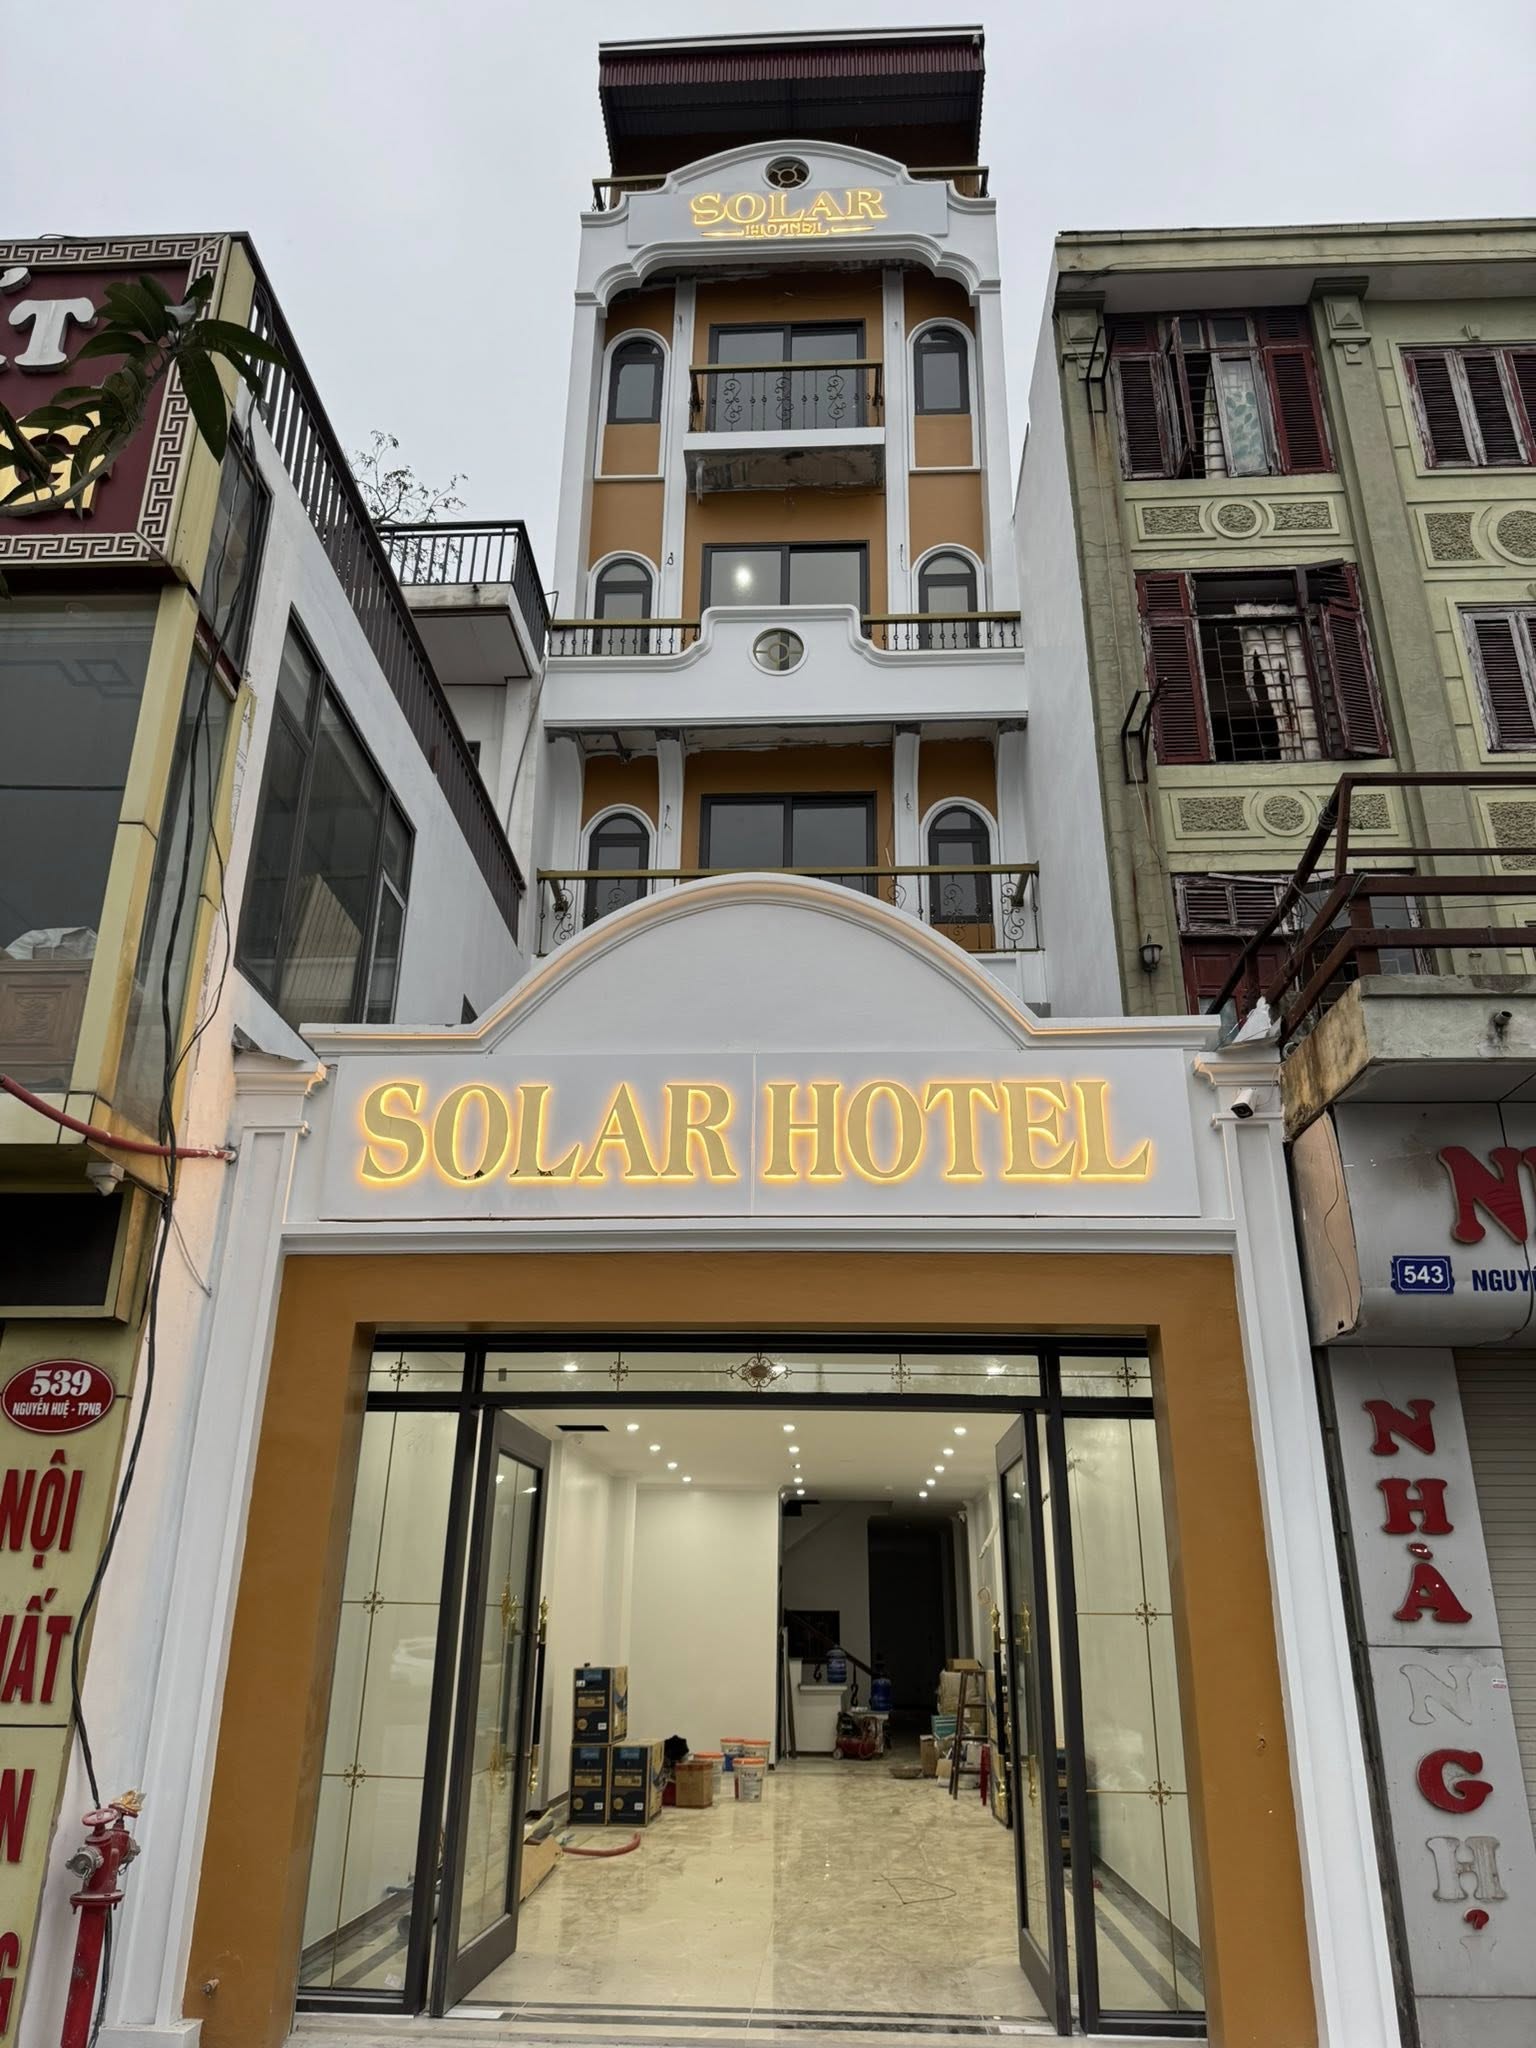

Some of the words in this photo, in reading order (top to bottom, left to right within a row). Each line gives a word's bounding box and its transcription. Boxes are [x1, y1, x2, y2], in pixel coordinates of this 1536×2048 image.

[690, 187, 888, 226] SOLAR
[745, 222, 829, 239] HOTEL
[361, 1082, 737, 1180] SOLAR
[763, 1081, 1151, 1179] HOTEL
[1403, 1265, 1444, 1284] 543
[30, 1369, 92, 1397] 539
[50, 1400, 70, 1419] HUỆ
[77, 1402, 102, 1416] TPNB
[0, 1449, 84, 1568] NỘI
